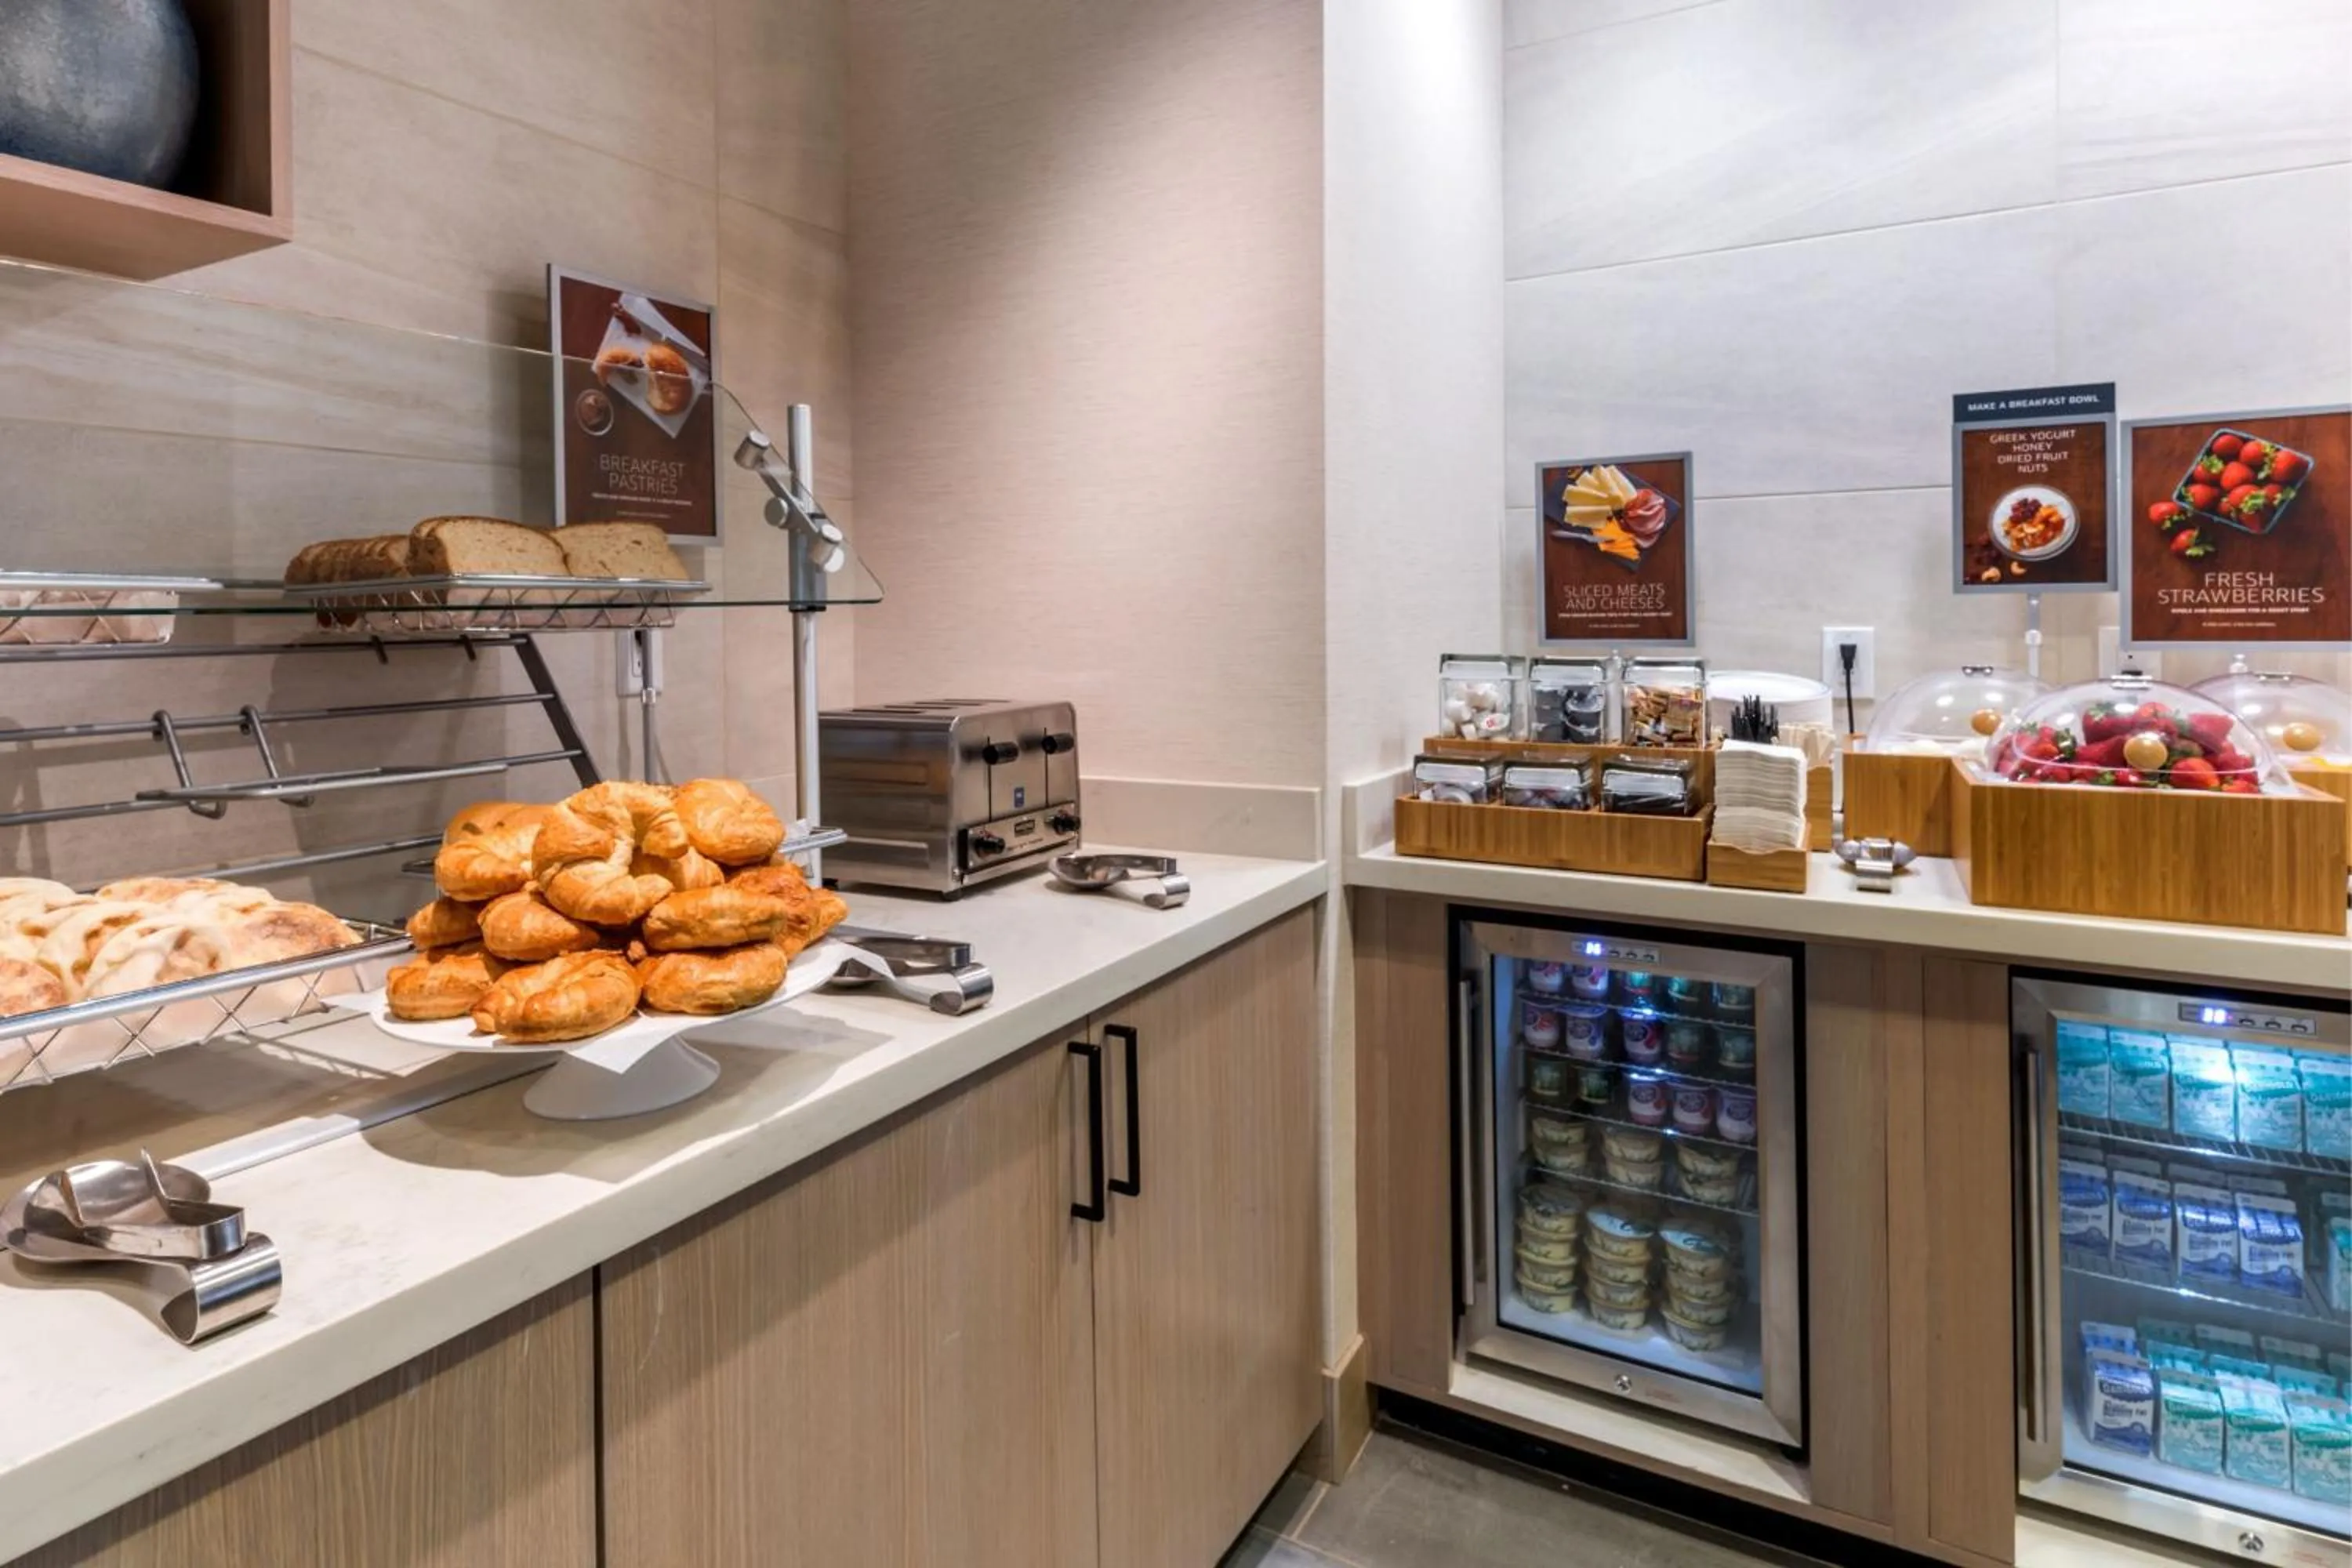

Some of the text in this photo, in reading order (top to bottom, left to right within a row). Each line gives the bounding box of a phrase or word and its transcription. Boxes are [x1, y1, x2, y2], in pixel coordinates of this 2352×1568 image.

[1968, 401, 1995, 412] MAKE
[2009, 396, 2066, 408] BREAKFAST
[2069, 394, 2100, 404] BOWL
[1990, 430, 2077, 445] GREEK YOGURT
[2013, 441, 2053, 452] HONEY
[1997, 451, 2069, 464] DRIED FRUIT
[600, 454, 687, 478] BREAKFAST
[2017, 463, 2049, 474] NUTS
[609, 472, 677, 494] PASTRIES
[2205, 572, 2274, 587] FRESH
[1563, 583, 1665, 597] SLICED MEATS
[2158, 587, 2325, 604] STRAWBERRIES
[1566, 596, 1664, 610] AND CHEESES
